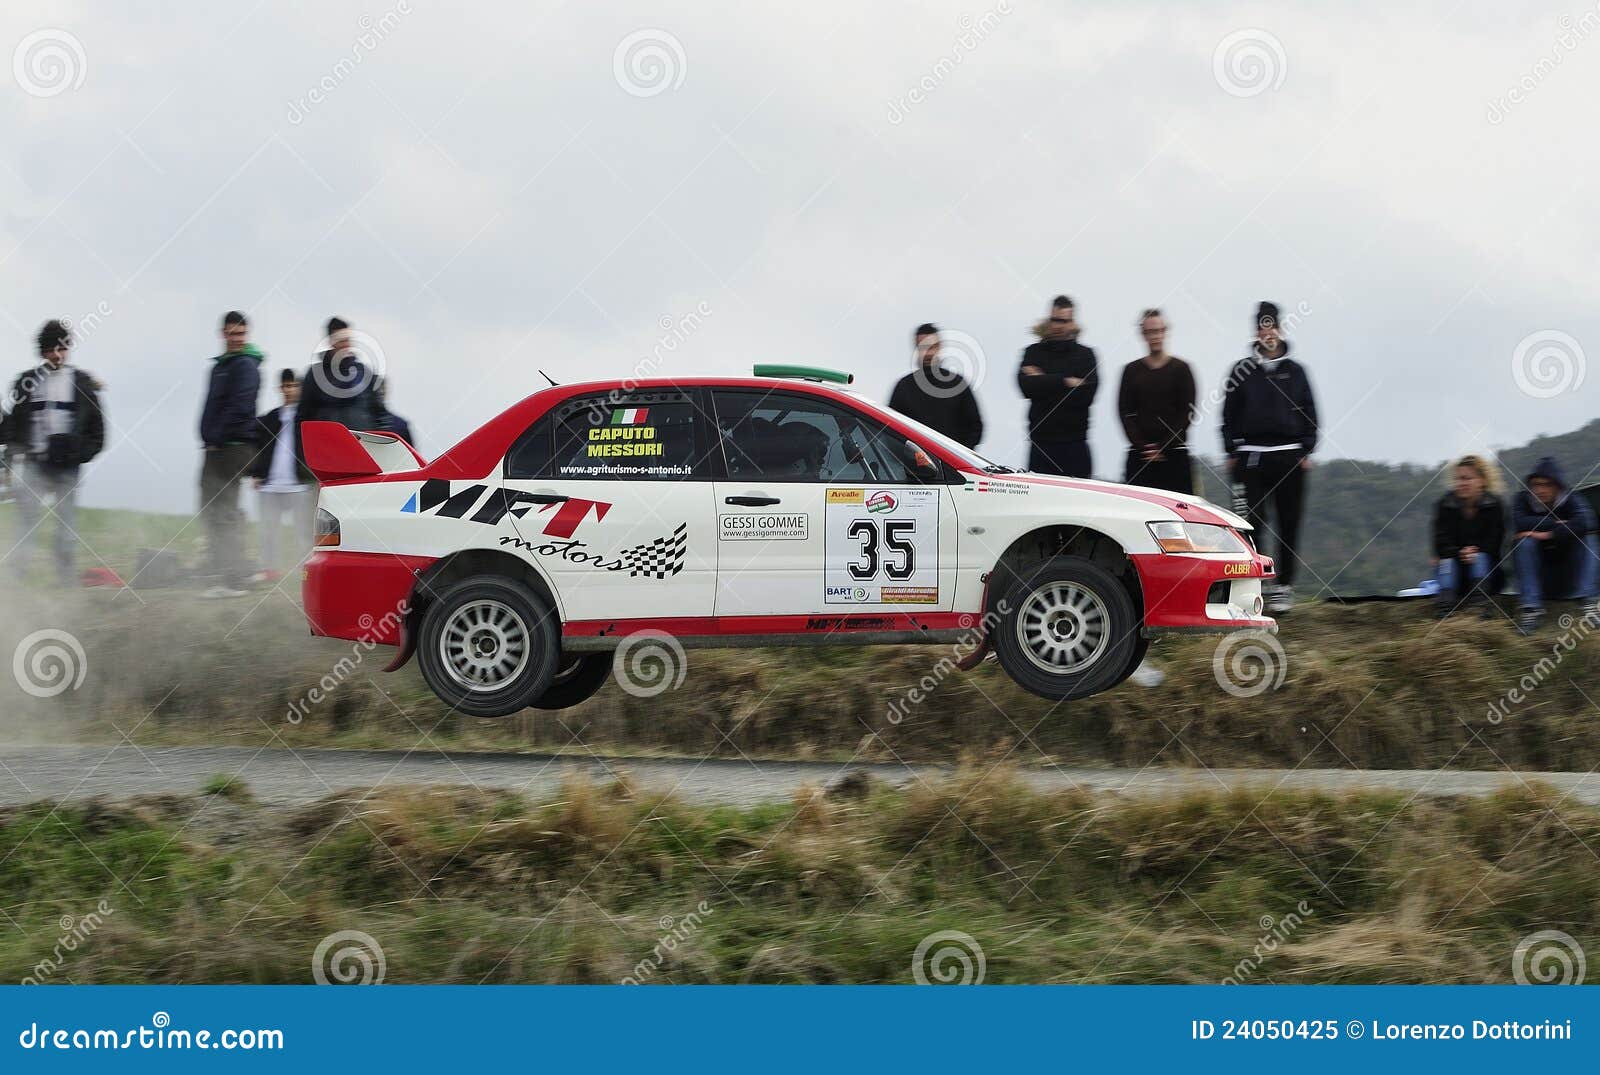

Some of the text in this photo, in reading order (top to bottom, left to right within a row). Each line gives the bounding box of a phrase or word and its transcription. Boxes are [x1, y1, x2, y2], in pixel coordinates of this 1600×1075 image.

[588, 427, 655, 441] CAPUTO
[587, 443, 662, 457] MESSORI
[560, 464, 692, 475] www.agriturismo-s-antonio.it
[723, 517, 804, 529] GESSI GOMME
[723, 530, 805, 538] www.gessigomme.com
[499, 535, 633, 571] motors
[847, 519, 916, 581] 35
